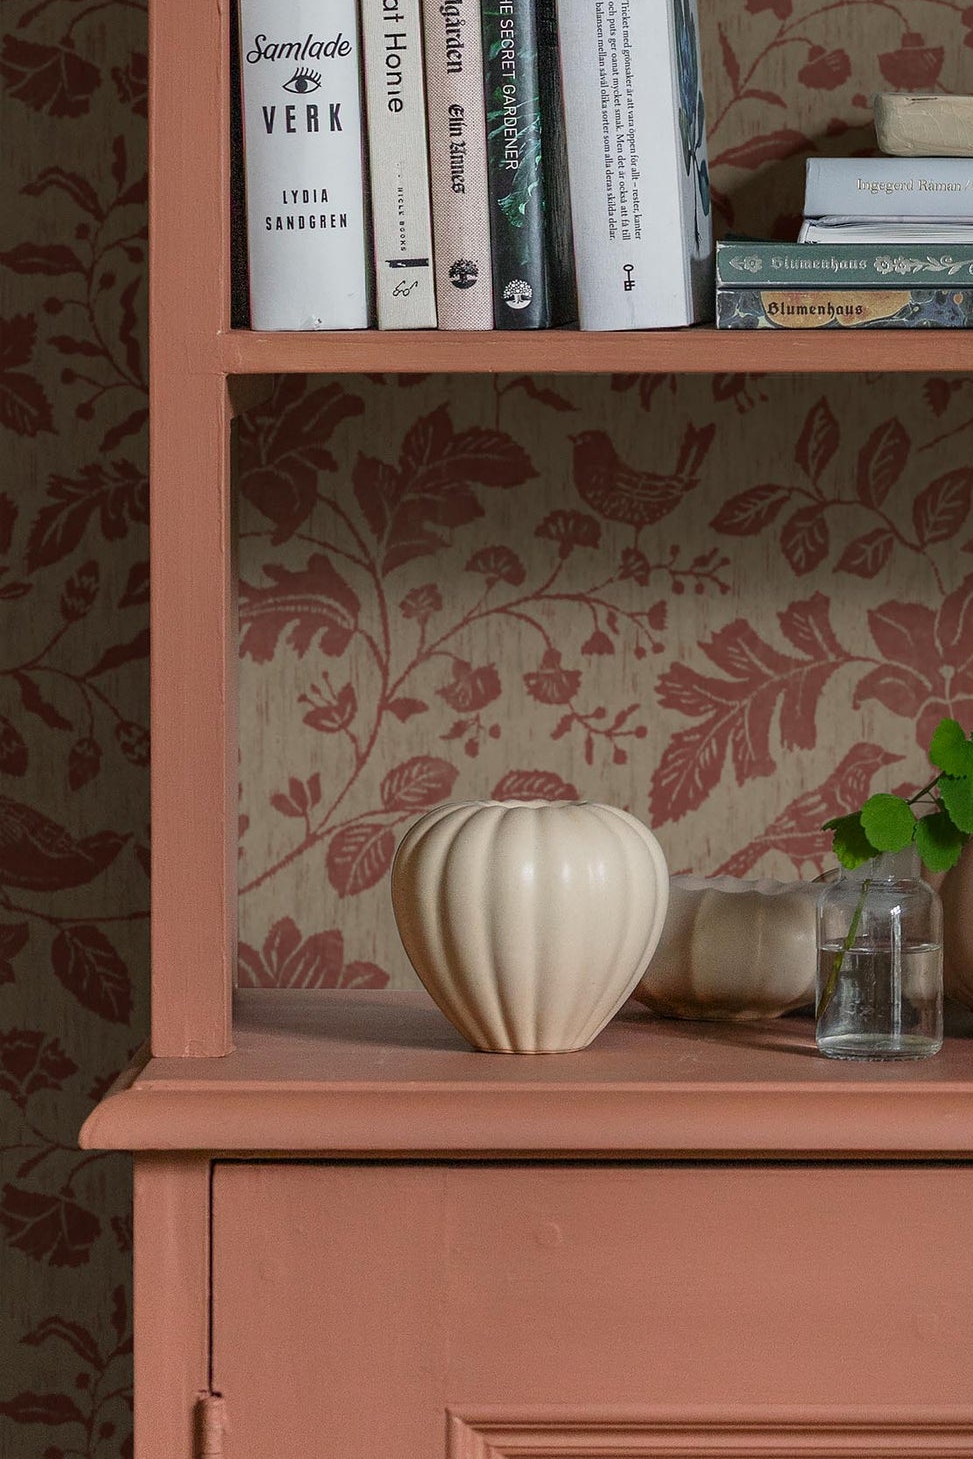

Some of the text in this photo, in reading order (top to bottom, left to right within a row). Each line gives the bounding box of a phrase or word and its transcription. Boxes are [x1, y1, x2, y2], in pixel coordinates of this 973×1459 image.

[595, 1, 605, 38] balansen
[608, 1, 617, 16] och
[621, 0, 631, 29] Tricket
[607, 18, 616, 36] puts
[246, 33, 352, 64] Samlade
[500, 18, 516, 78] SECRET
[608, 38, 617, 51] ger
[622, 30, 632, 48] med
[598, 39, 607, 66] mellan
[611, 52, 619, 75] oanat
[383, 33, 407, 113] Home
[622, 49, 634, 87] grönsaker
[600, 89, 610, 109] olika
[610, 77, 622, 107] mycket
[262, 103, 343, 134] VERK
[448, 104, 468, 137] Elin
[502, 84, 519, 170] GARDENER
[602, 110, 610, 133] sorter
[615, 109, 624, 132] smak.
[616, 134, 625, 153] Men
[626, 128, 636, 153] öppen
[604, 154, 613, 168] alla
[617, 154, 626, 169] det
[630, 155, 639, 166] för
[605, 169, 614, 191] deras
[631, 168, 640, 180] allt
[282, 188, 329, 205] LYDIA
[619, 181, 628, 203] också
[857, 178, 914, 194] Ingegerd
[918, 178, 961, 192] Råman
[607, 193, 616, 216] skilda
[620, 205, 628, 217] att
[632, 189, 640, 213] rester,
[265, 213, 348, 231] SANDGREN
[608, 218, 618, 240] delar.
[634, 214, 643, 240] kanter
[622, 228, 631, 240] till
[771, 255, 867, 272] Blumenhaus
[767, 301, 864, 319] Blumenhaus
